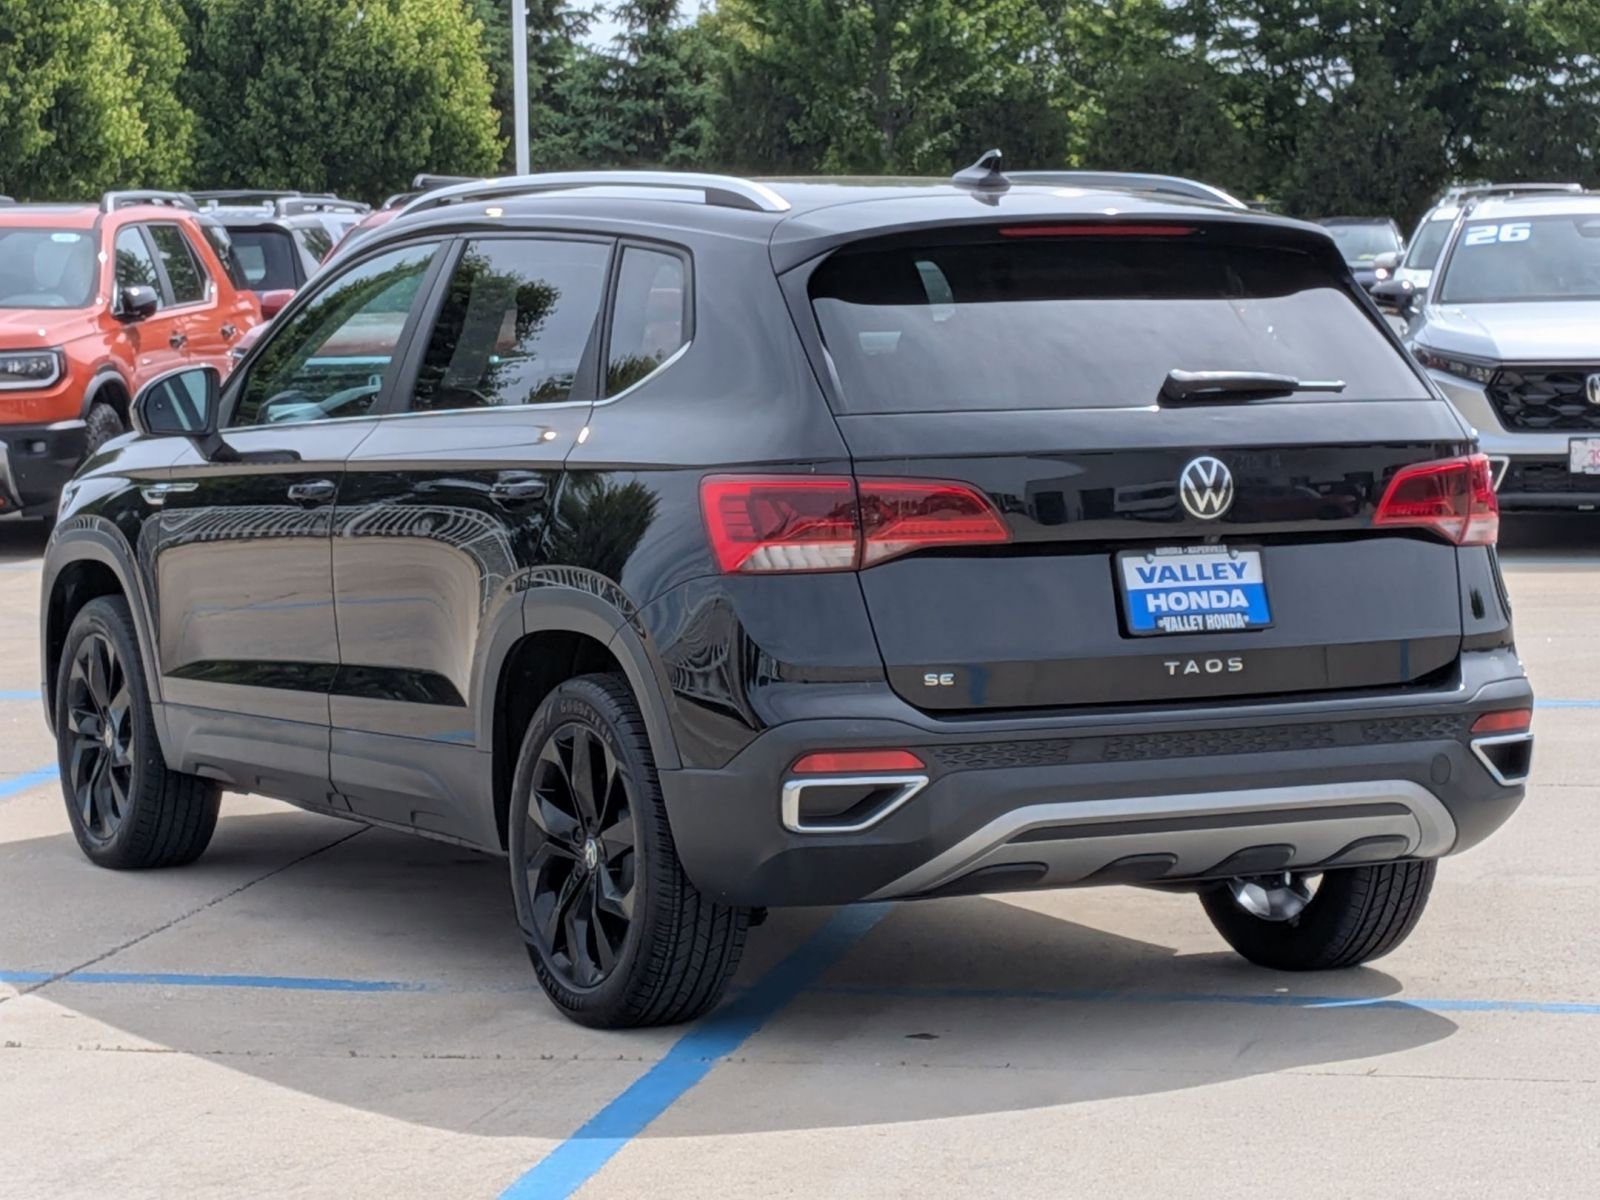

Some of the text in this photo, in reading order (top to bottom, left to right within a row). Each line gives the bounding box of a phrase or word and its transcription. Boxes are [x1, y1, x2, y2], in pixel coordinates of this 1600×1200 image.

[1465, 222, 1532, 246] 26
[1136, 562, 1248, 583] VALLEY
[1146, 589, 1248, 612] HONDA
[1163, 612, 1246, 632] VALLEY HONDA
[1164, 657, 1244, 675] TAOS
[924, 673, 954, 686] SE
